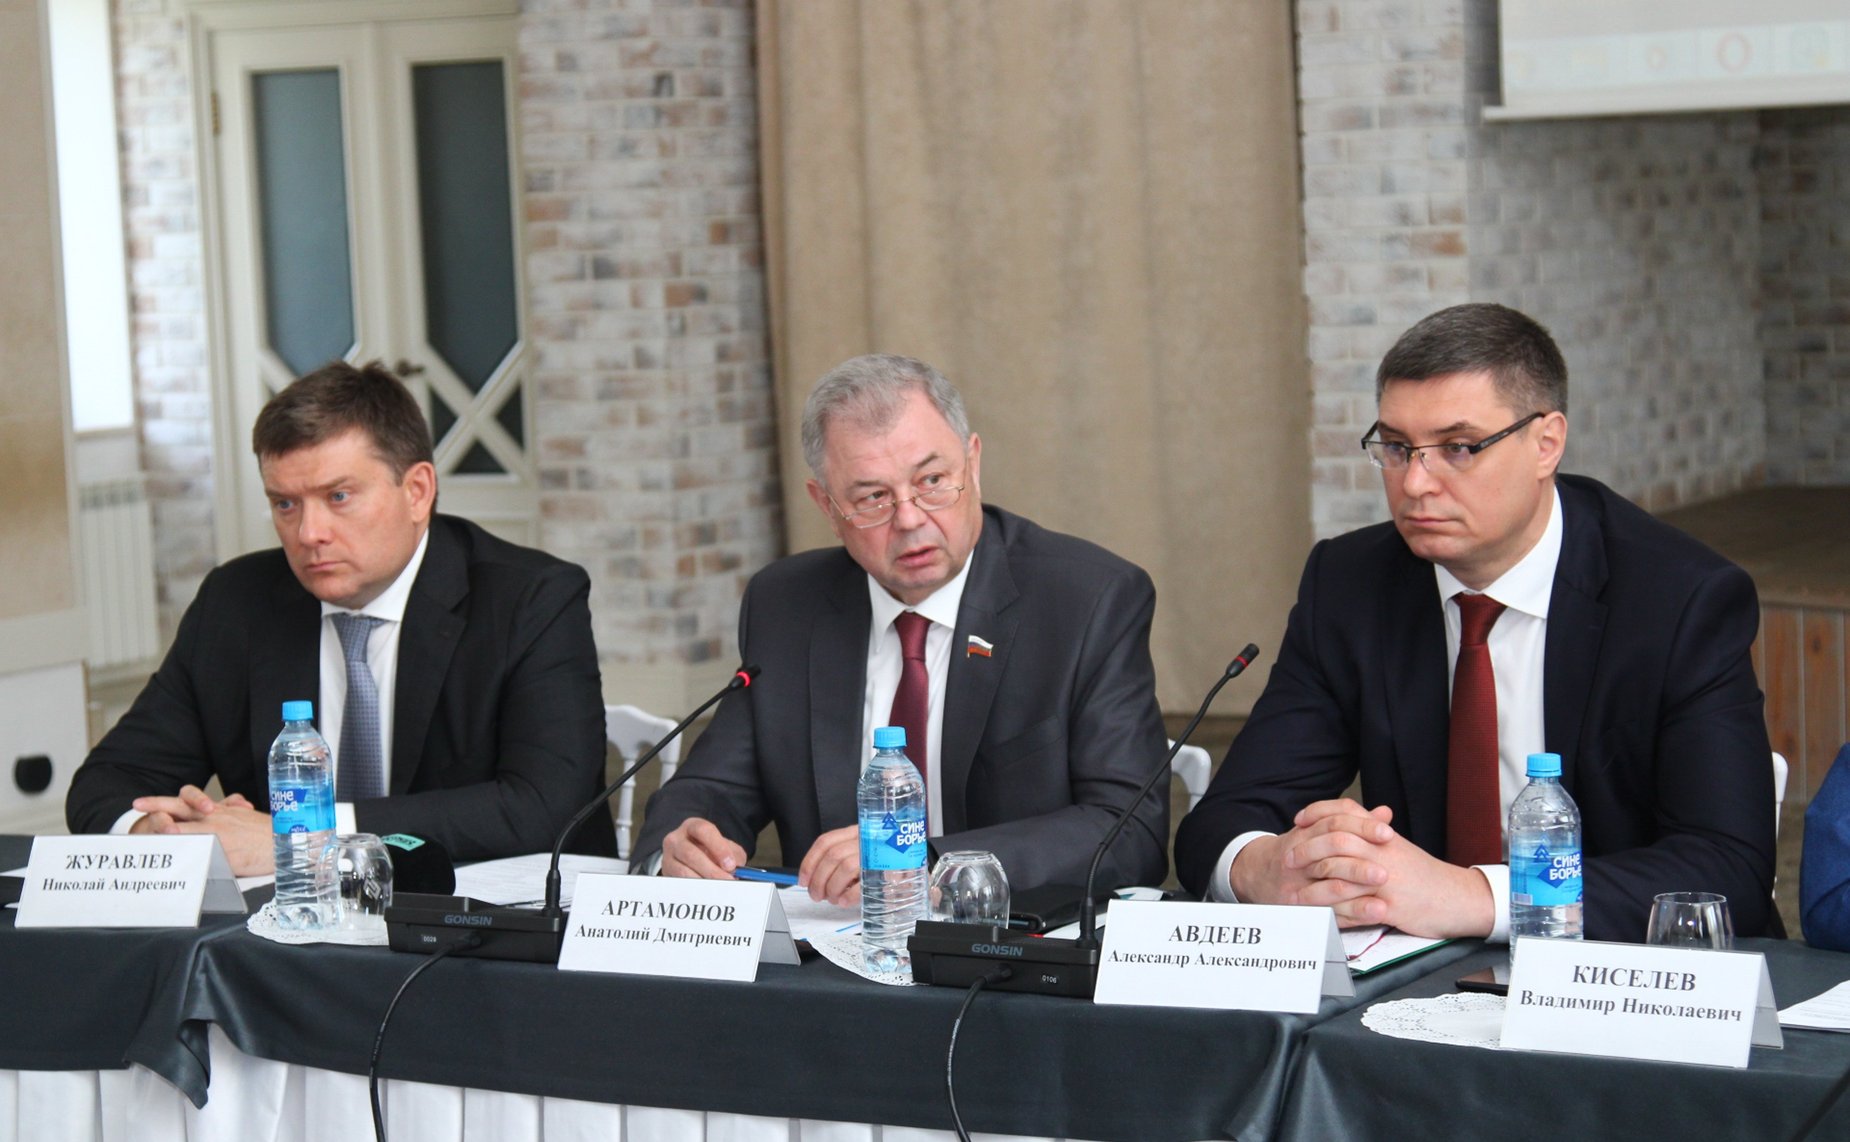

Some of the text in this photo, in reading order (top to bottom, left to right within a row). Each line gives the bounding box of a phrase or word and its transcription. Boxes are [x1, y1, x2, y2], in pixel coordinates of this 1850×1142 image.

[65, 854, 173, 870] ЖУРАВЛЕВ
[42, 878, 187, 893] Николай Андреевич
[444, 914, 493, 926] GONSIN
[601, 899, 736, 922] АРТАМОНОВ
[575, 924, 752, 947] Анатолий Дмитриевич
[1168, 925, 1262, 945] АВДЕЕВ
[971, 943, 1023, 956] GONSIN
[1108, 950, 1317, 972] Александр Александрович
[1572, 965, 1697, 991] КИСЕЛЕВ
[1520, 990, 1742, 1022] Владимир Николаевич
